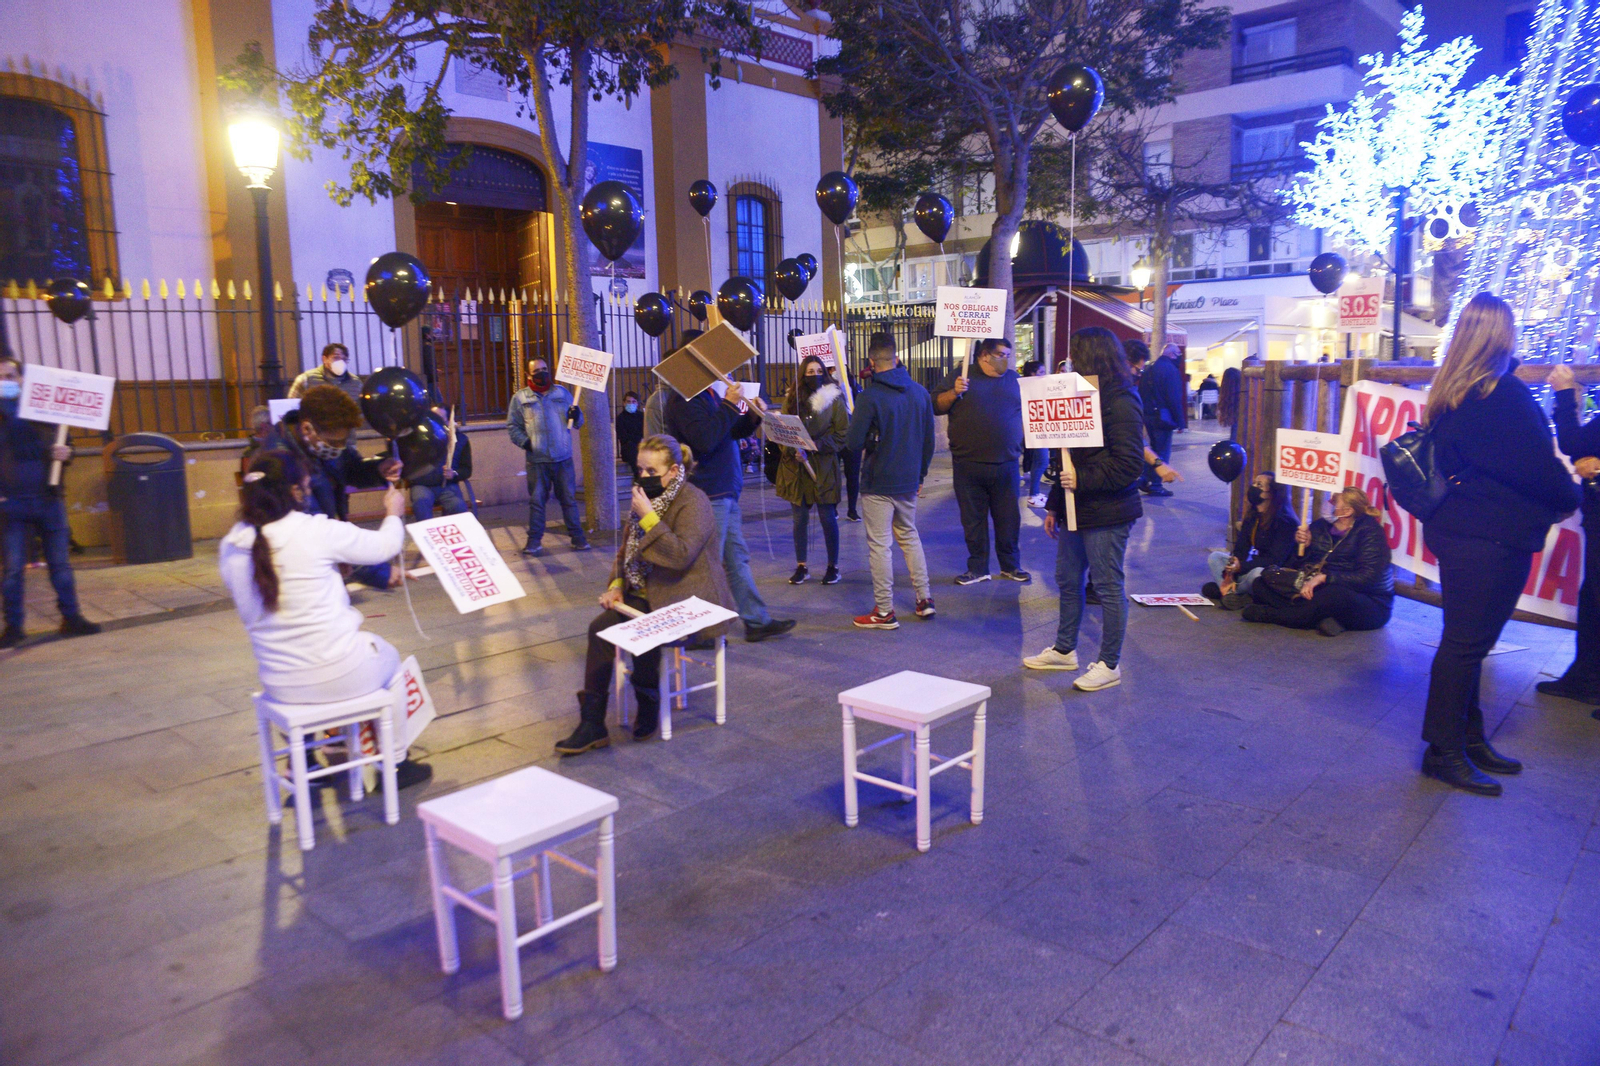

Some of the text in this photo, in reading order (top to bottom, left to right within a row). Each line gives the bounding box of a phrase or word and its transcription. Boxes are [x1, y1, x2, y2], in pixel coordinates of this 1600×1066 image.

[944, 303, 960, 311] NOS
[962, 304, 999, 312] OBLIGAIS
[1211, 297, 1239, 306] Plaza
[1341, 295, 1379, 317] S.O.S
[958, 311, 991, 319] CERRAR
[961, 318, 987, 326] PAGAR
[947, 325, 992, 333] IMPUESTOS
[800, 346, 809, 358] SE
[562, 355, 606, 378] SE TRASPASA
[31, 383, 105, 410] SE VENDE
[1028, 396, 1093, 422] SE VENDE
[1029, 420, 1095, 433] BAR CON DEUDAS
[1281, 447, 1340, 475] S.O.S
[1281, 469, 1337, 485] HOSTELERIA
[437, 524, 467, 546] SE
[426, 527, 480, 602] BAR CON DEUDAS
[451, 545, 501, 598] VENDE
[619, 604, 686, 631] IMPUESTOS
[635, 613, 673, 630] PAGAR
[636, 615, 684, 635] CERRAR
[687, 609, 712, 621] NOS
[630, 620, 686, 643] OBLIGAIS
